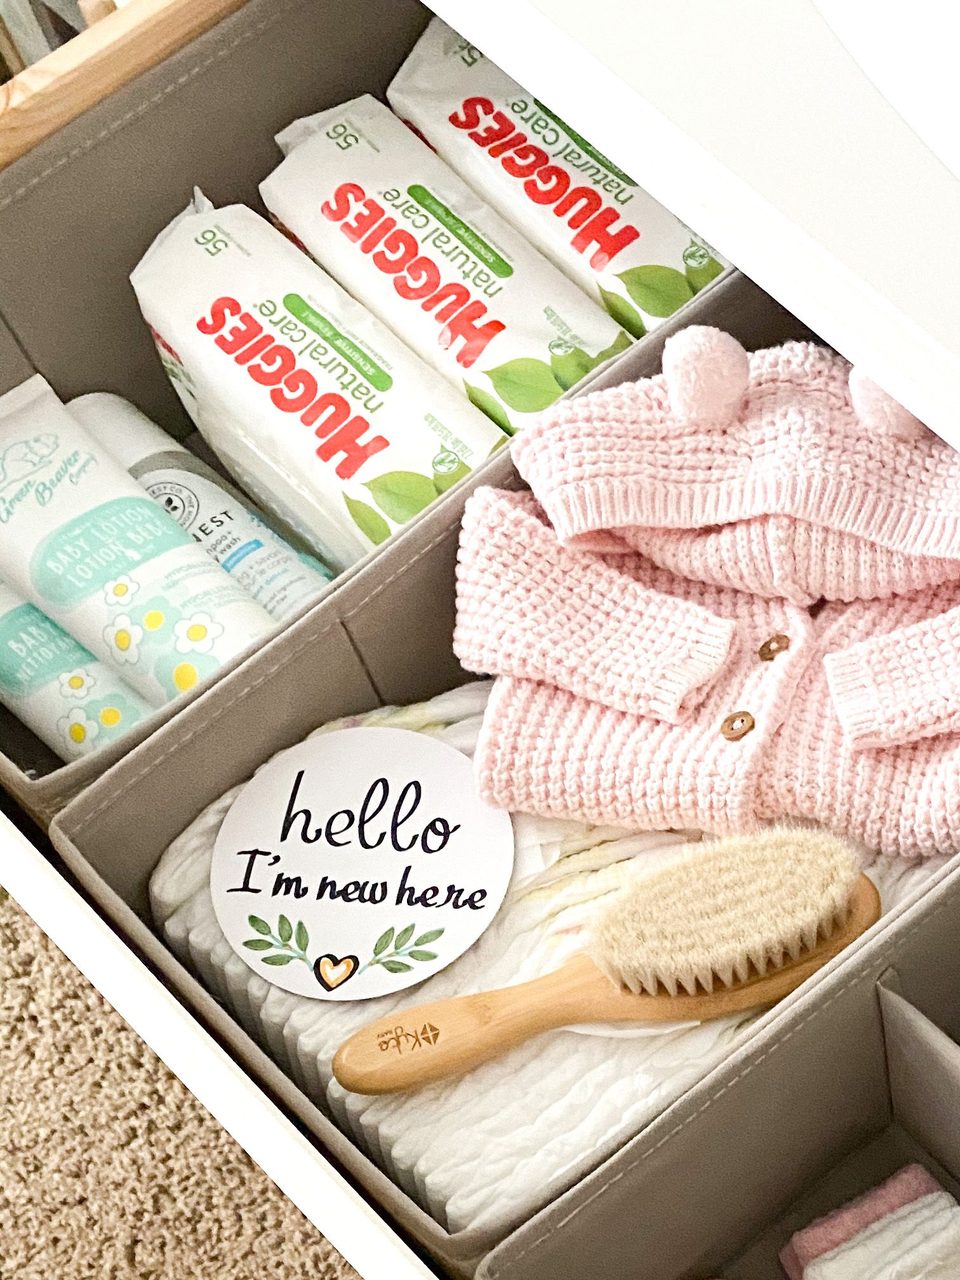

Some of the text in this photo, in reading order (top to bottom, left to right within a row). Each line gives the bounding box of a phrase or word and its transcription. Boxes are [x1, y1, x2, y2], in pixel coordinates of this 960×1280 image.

[325, 123, 359, 151] 56
[510, 99, 635, 206] natural care
[382, 188, 430, 229] care
[448, 96, 640, 273] HUGGIES
[194, 229, 229, 256] 56
[321, 182, 506, 368] HUGGIES
[421, 227, 503, 299] natural
[258, 299, 309, 344] care
[196, 296, 391, 480] HUGGIES
[299, 336, 384, 414] natural
[34, 450, 81, 507] Beaver
[46, 537, 91, 575] BABY
[90, 505, 154, 543] LOTION
[66, 541, 125, 588] LOTION
[280, 770, 462, 854] hello
[226, 848, 488, 911] I'm new here
